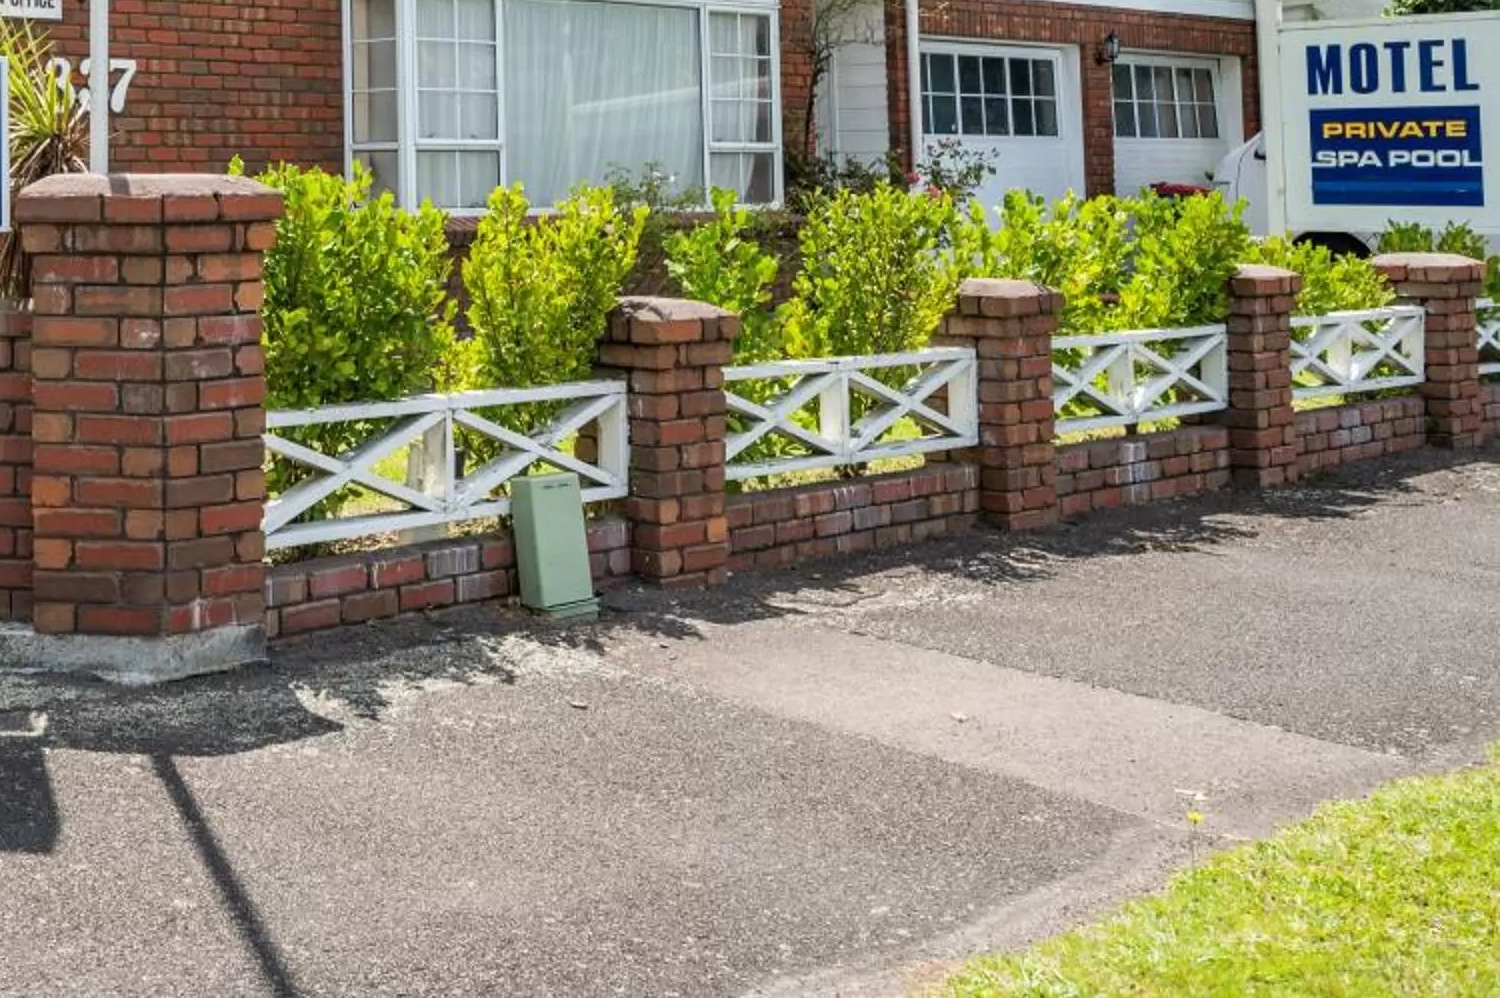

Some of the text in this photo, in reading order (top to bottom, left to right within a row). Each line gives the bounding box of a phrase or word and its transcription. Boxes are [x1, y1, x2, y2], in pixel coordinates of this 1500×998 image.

[1306, 38, 1480, 96] MOTEL
[1323, 120, 1466, 139] PRIVATE
[1313, 149, 1480, 168] SPA POOL
